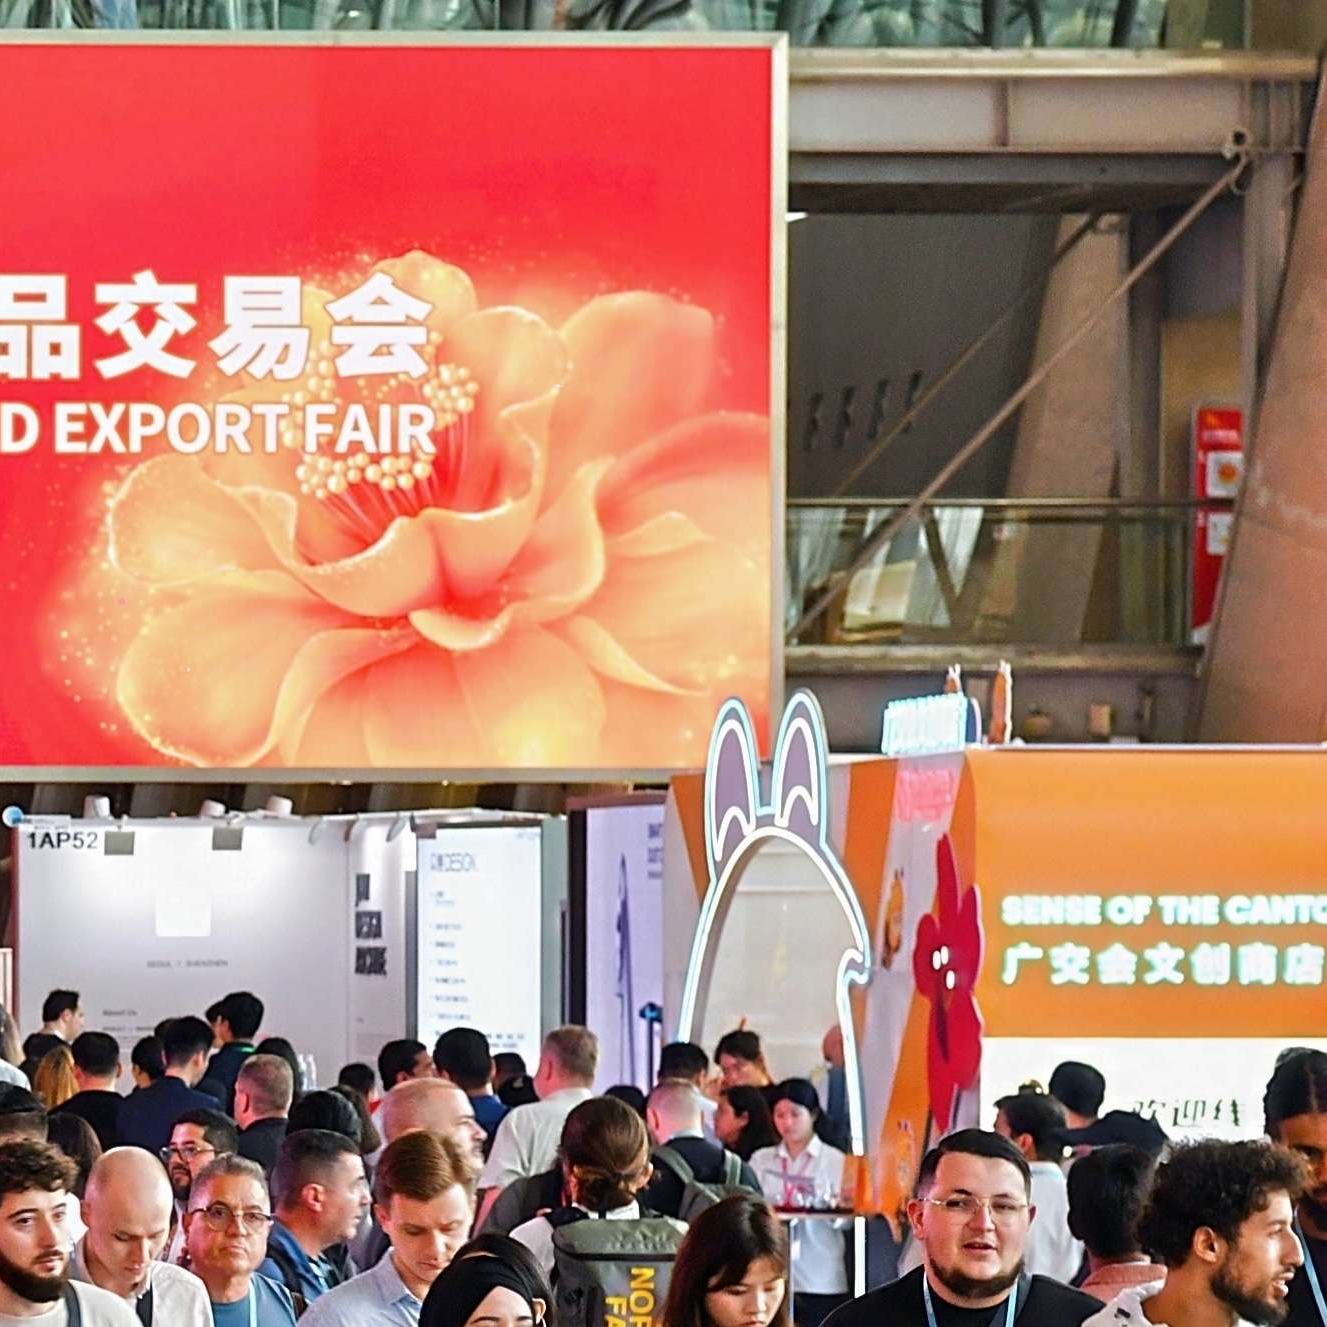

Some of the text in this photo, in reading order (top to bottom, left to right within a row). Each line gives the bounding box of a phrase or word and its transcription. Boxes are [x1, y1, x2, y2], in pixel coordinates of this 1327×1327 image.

[55, 402, 297, 454] EXPORT
[305, 403, 436, 454] FAIR
[28, 831, 98, 849] 1AP52
[1001, 894, 1103, 926] SENSE
[1106, 894, 1153, 926] OF
[1157, 894, 1221, 926] THE
[1001, 941, 1326, 986] 广交会文创商店
